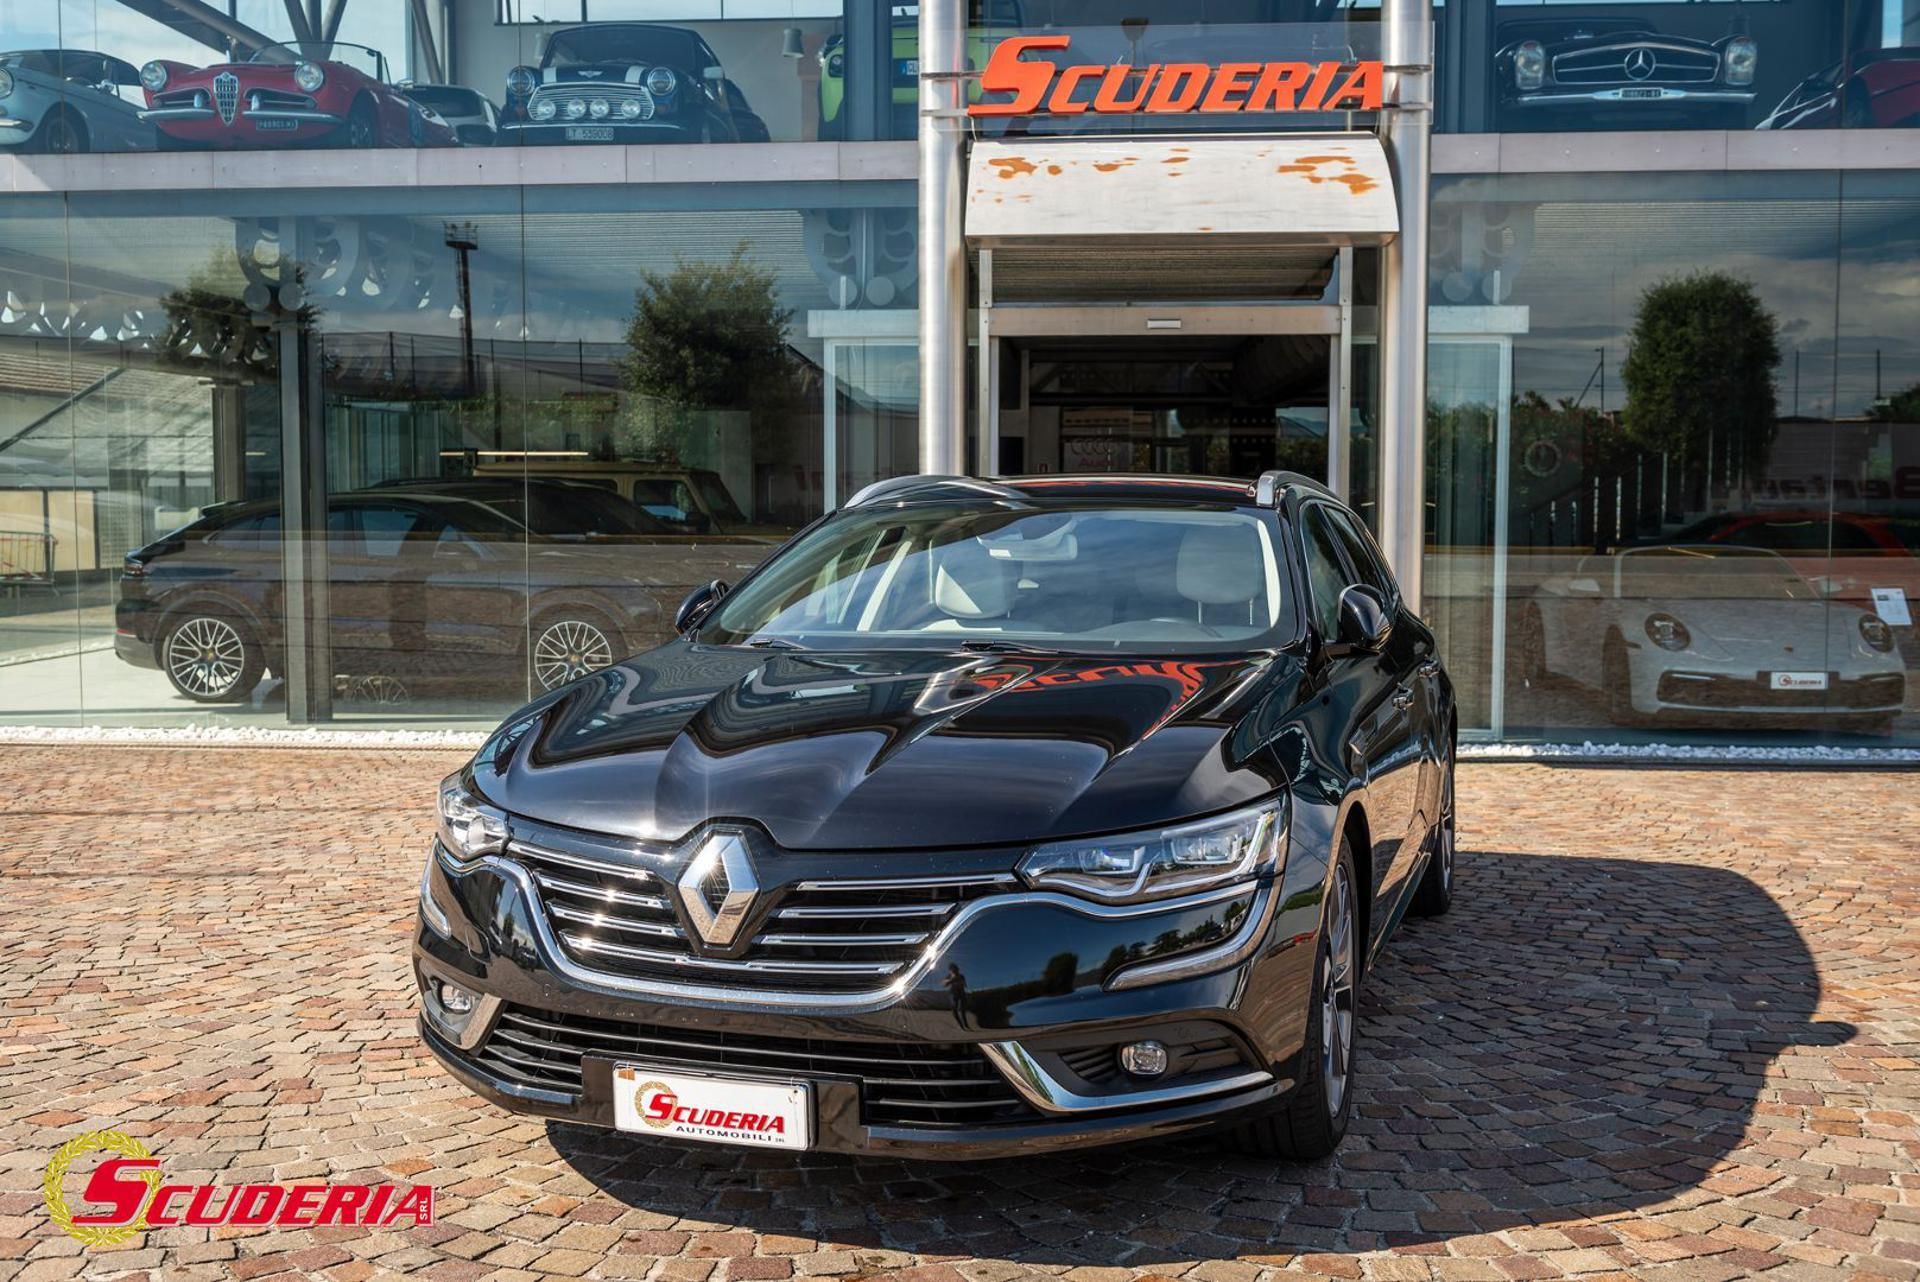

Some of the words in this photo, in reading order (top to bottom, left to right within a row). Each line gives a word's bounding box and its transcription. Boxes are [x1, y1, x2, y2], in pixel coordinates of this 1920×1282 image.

[967, 35, 1383, 116] SCUDERIA
[645, 1093, 785, 1134] SCUDERIA
[676, 1125, 772, 1141] AUTOMOBILI
